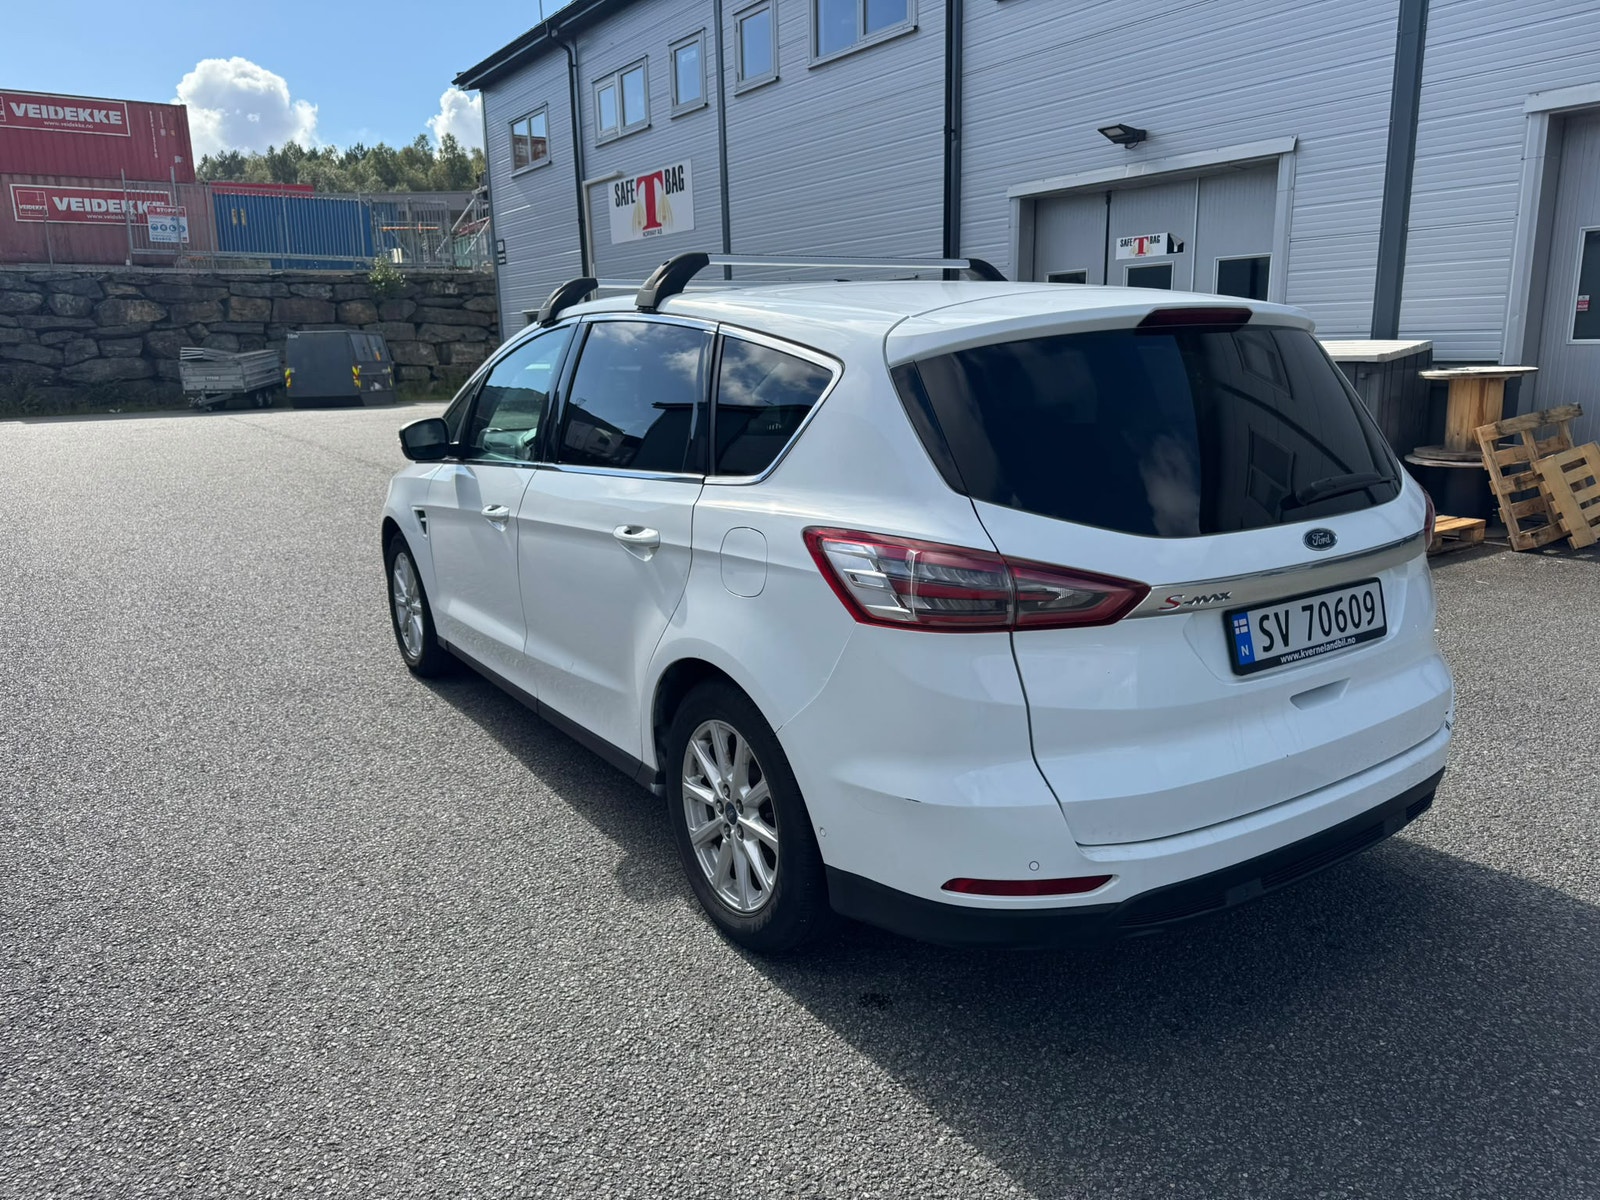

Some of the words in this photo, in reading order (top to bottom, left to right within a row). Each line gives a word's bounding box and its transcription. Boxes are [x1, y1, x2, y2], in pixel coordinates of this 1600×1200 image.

[10, 102, 122, 124] VEIDEKKE
[615, 179, 635, 207] SAFE
[636, 170, 663, 230] T
[664, 164, 685, 195] BAG
[1120, 238, 1132, 247] SAFE
[1133, 236, 1148, 254] T
[1150, 235, 1160, 244] BAG
[1312, 532, 1330, 545] Ford
[1258, 609, 1290, 653] SV
[1301, 590, 1376, 642] 70609
[1241, 645, 1249, 656] N
[1280, 637, 1356, 663] www.kvernelandbil.no
